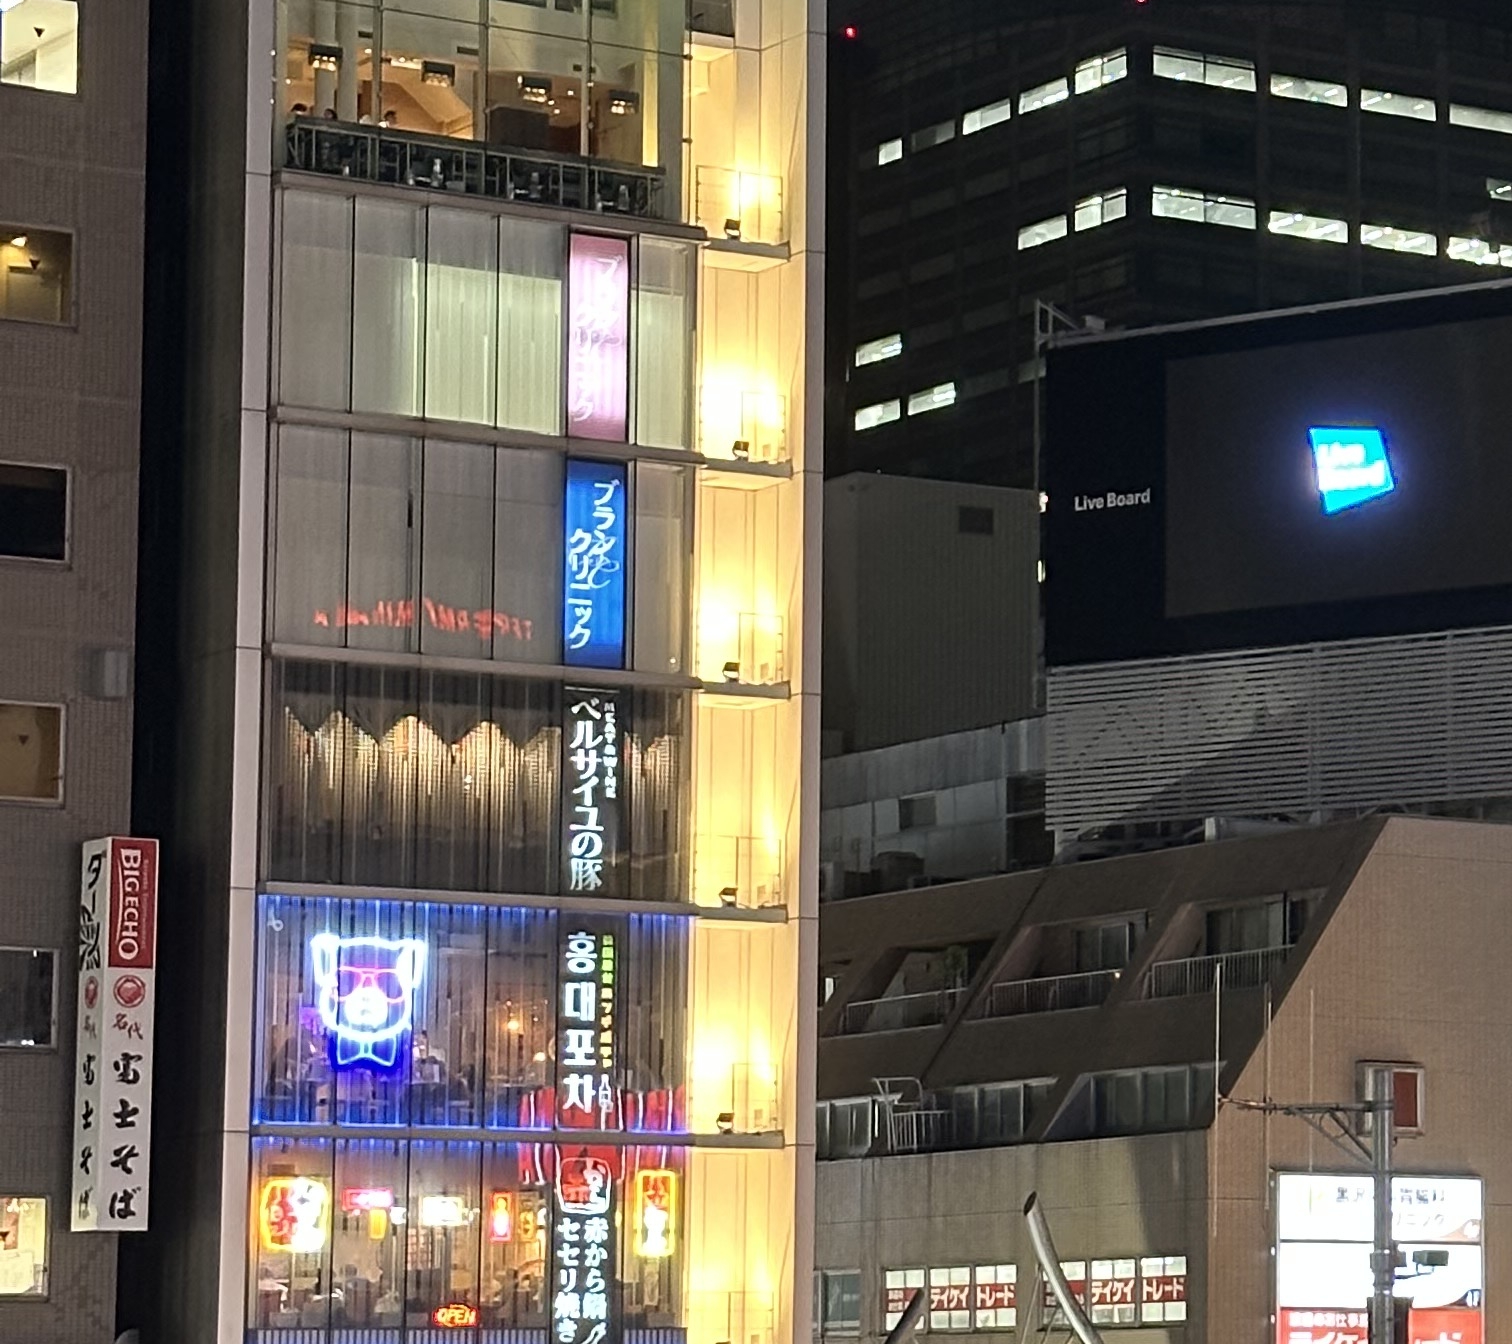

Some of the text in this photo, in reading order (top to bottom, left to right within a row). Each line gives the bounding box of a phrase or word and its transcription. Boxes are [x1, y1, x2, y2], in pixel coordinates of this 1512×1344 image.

[1074, 487, 1151, 512] Live Board
[567, 528, 594, 650] クリニック
[569, 697, 604, 892] ベルサイユの豚
[563, 931, 600, 1114] 홍대포차
